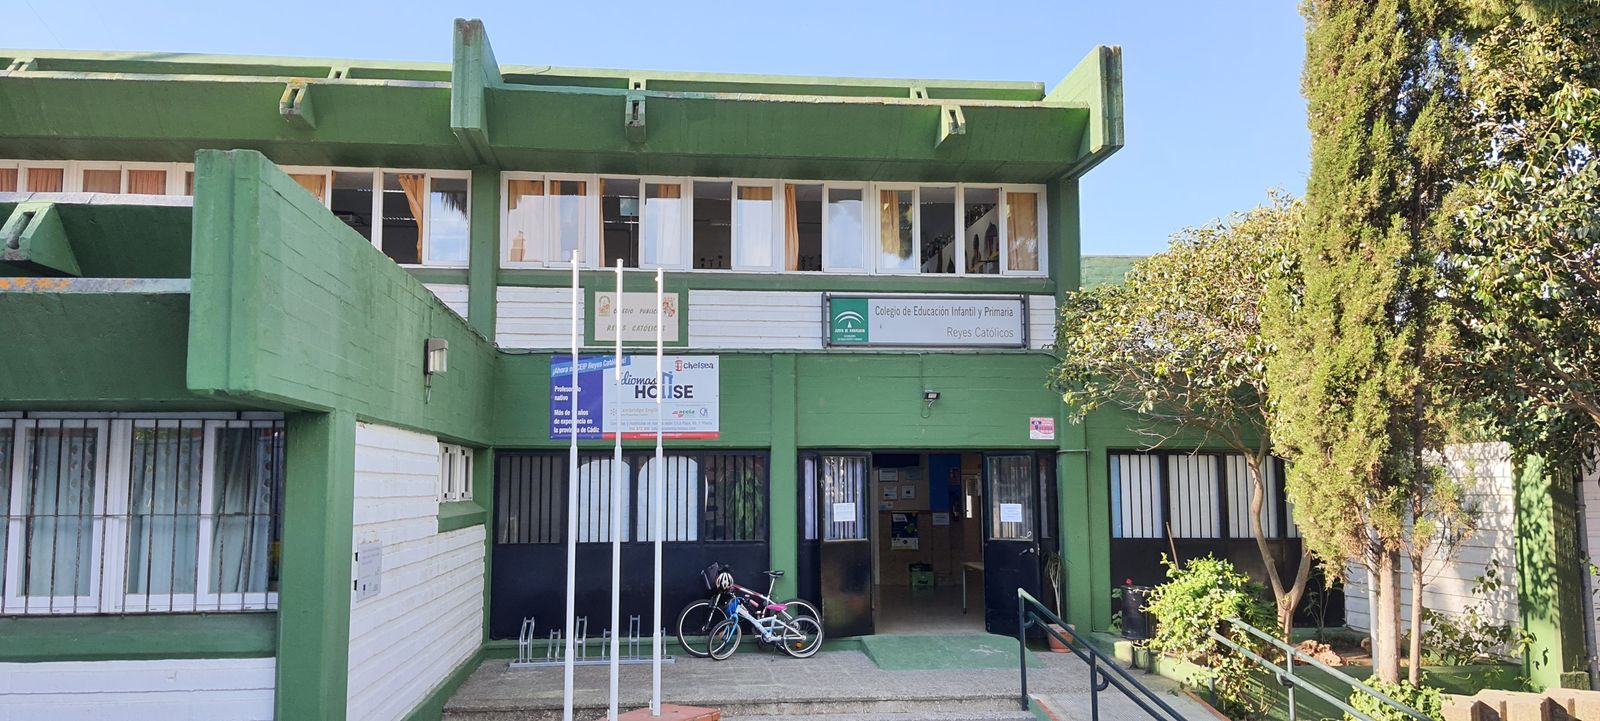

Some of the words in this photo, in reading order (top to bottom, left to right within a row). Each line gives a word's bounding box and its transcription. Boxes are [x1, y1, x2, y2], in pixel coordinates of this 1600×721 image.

[875, 305, 900, 318] Colegio
[902, 305, 912, 316] de
[913, 304, 949, 317] Educación
[951, 305, 976, 317] Infantil
[977, 309, 983, 319] y
[984, 306, 1014, 317] Primaria
[946, 327, 972, 339] Reyes
[974, 326, 1014, 338] Católicos
[588, 361, 603, 370] Reyes
[614, 371, 658, 386] diomas
